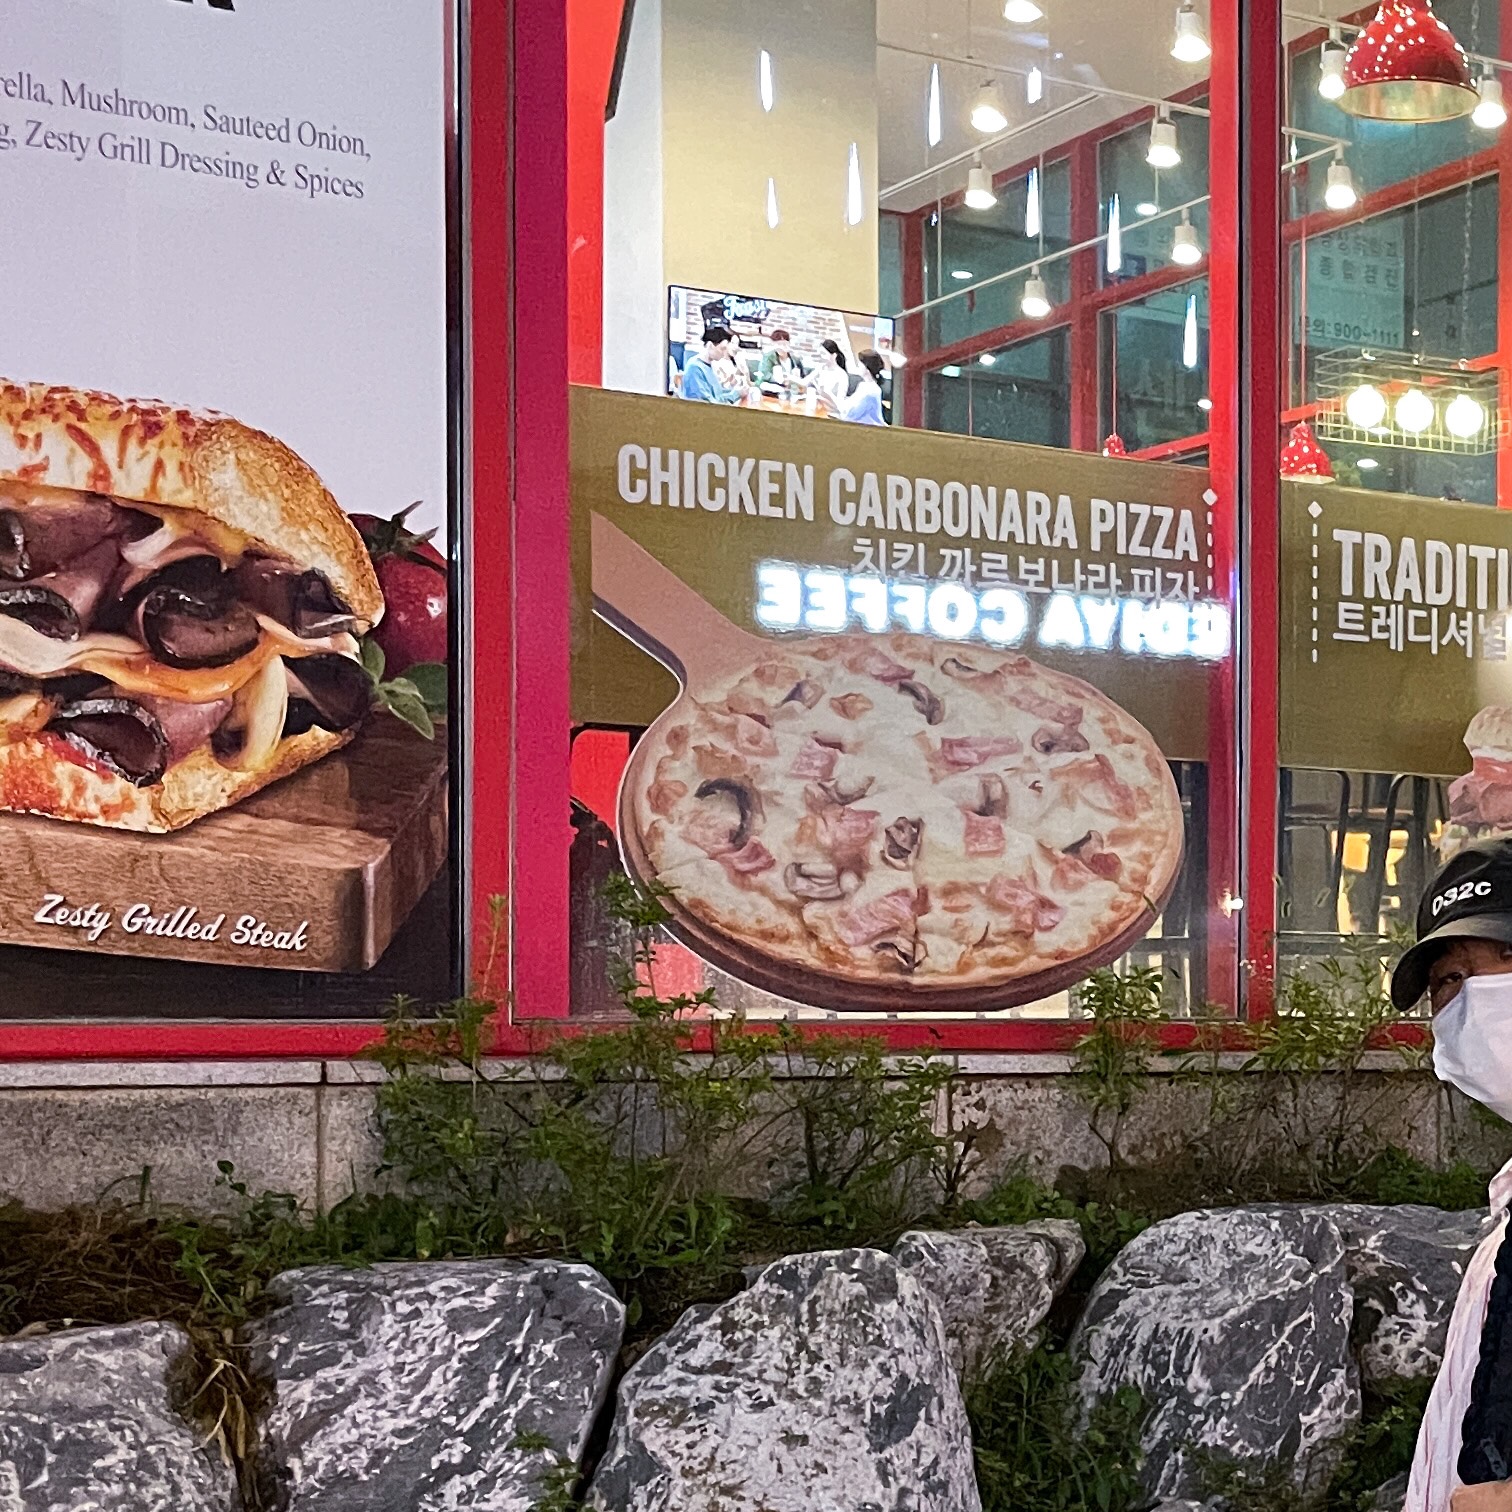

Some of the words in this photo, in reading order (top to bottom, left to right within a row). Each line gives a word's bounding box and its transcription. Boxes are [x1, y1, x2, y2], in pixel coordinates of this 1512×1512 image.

[25, 119, 91, 162] Zesty
[98, 131, 151, 165] Grill
[160, 140, 260, 189] Dressing
[266, 159, 287, 187] &
[294, 163, 365, 199] Spices
[61, 78, 196, 131] Mushroom,
[203, 103, 291, 144] Sauteed
[297, 120, 371, 163] Onion,
[617, 443, 815, 521] CHICKEN
[828, 467, 1078, 550] CARBONARA
[1090, 498, 1199, 562] PIZZA
[34, 893, 112, 942] Zesty
[121, 903, 225, 941] Grilled
[230, 914, 308, 951] Steak
